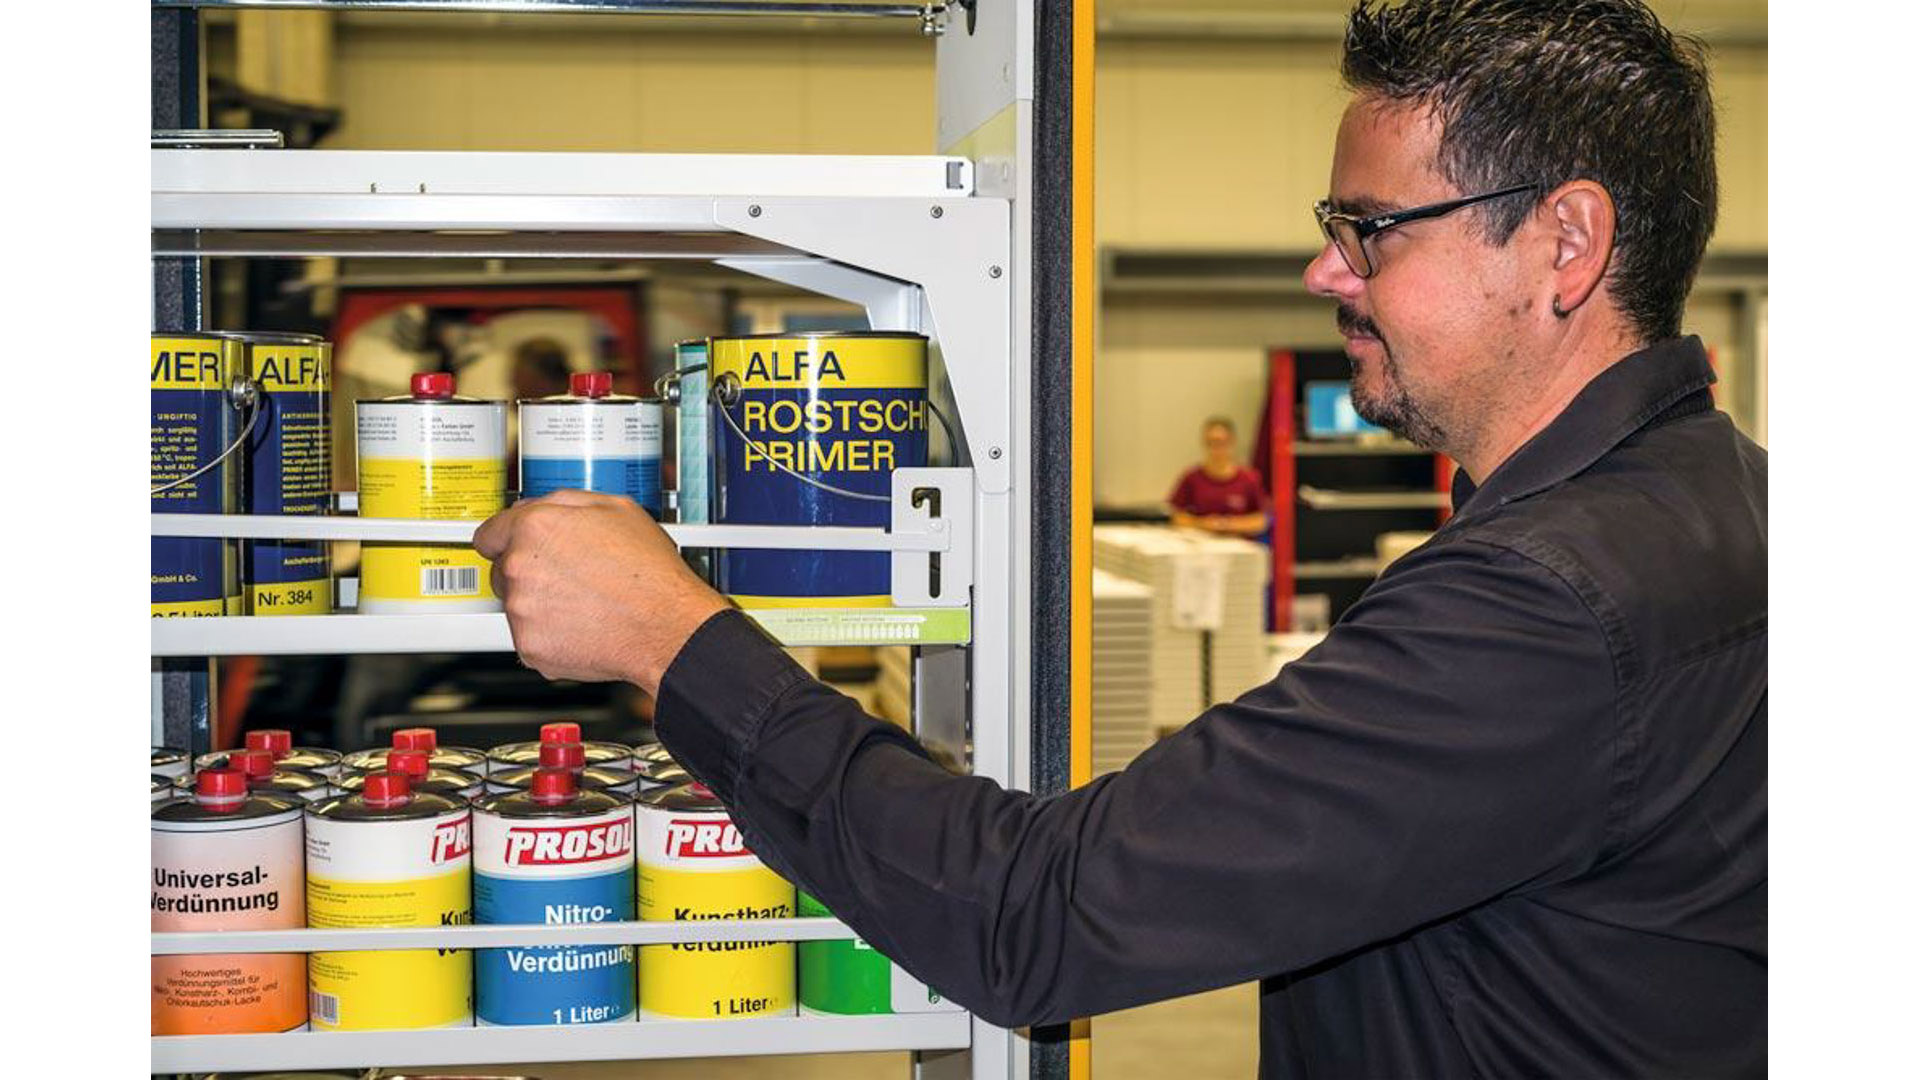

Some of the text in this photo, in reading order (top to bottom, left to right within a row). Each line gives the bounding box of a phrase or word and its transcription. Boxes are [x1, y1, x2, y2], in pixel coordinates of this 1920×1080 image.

[744, 351, 845, 382] ALFA
[744, 440, 894, 472] PRIMER
[258, 590, 313, 607] Nr. 384
[506, 822, 632, 868] PROSOL
[666, 823, 744, 860] PRO
[154, 865, 268, 888] Universal-
[544, 904, 613, 925] Nitro-
[553, 1006, 610, 1024] 1 Liter
[713, 997, 768, 1015] 1 Liter
